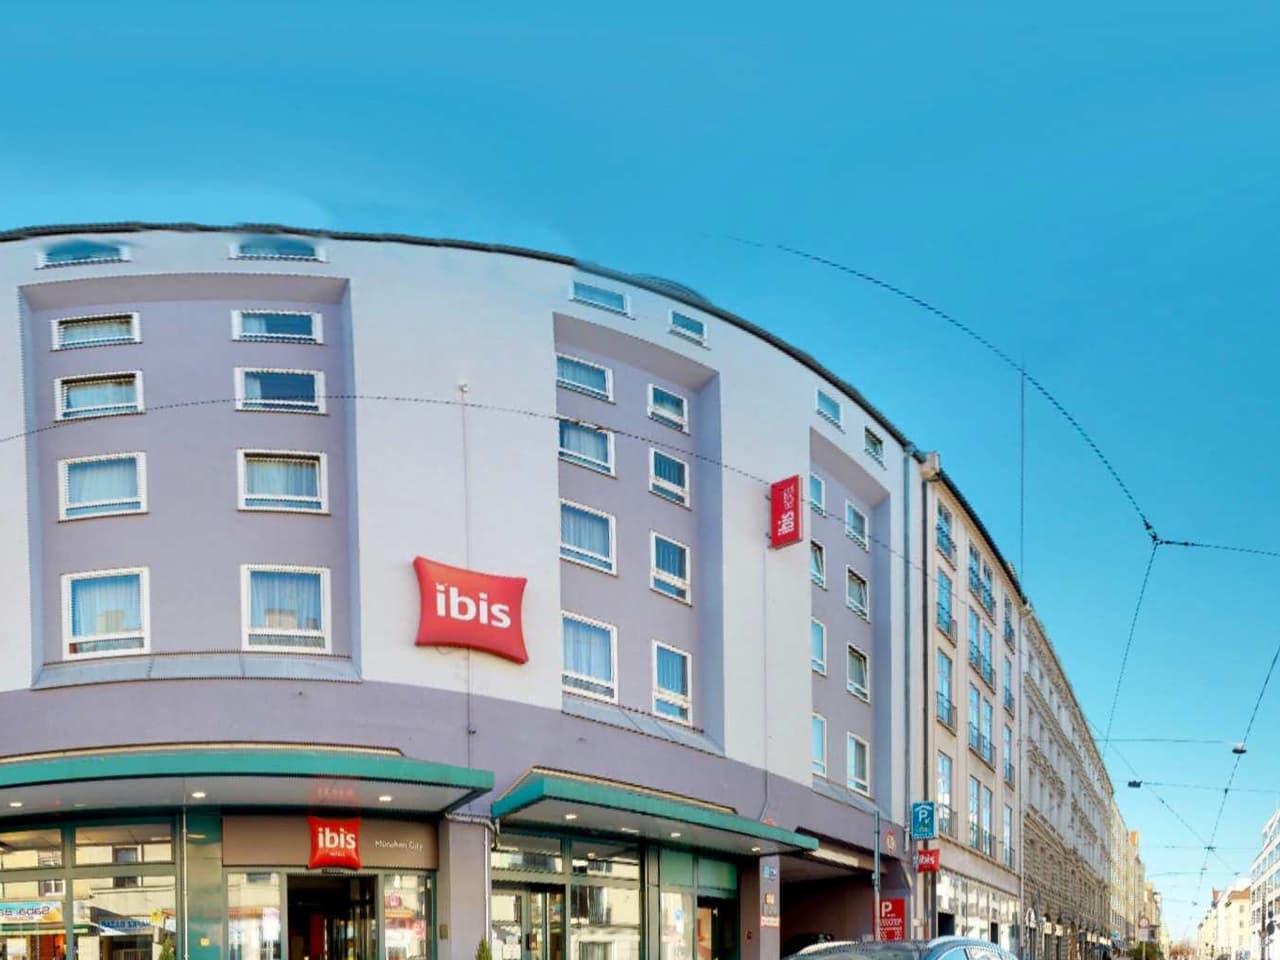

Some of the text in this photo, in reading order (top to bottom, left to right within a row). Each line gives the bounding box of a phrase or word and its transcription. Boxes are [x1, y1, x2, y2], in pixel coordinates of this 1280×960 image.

[778, 511, 795, 536] ibis
[435, 582, 512, 629] ibis
[318, 827, 357, 849] ibis
[881, 901, 892, 917] P
